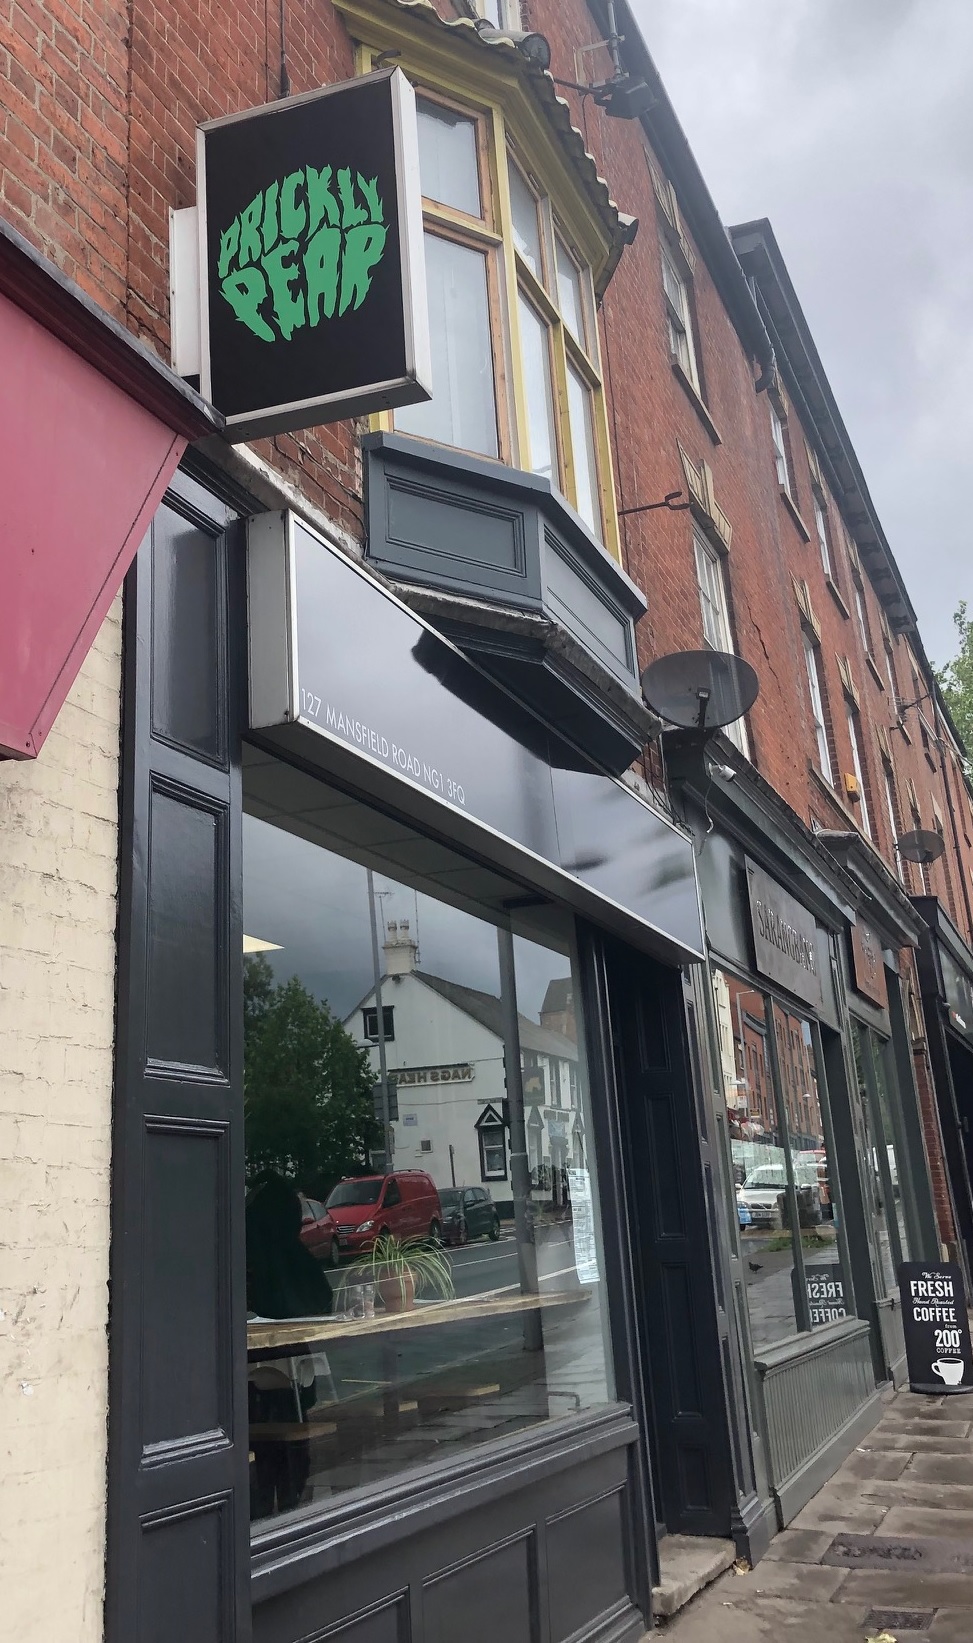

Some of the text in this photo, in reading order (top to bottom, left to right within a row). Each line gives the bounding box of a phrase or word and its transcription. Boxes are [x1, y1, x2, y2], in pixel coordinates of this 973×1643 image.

[217, 164, 384, 278] PRICKLY
[218, 223, 390, 342] PEAR
[301, 688, 466, 806] 127 MANSFIELD ROAD NG1 3FQ
[910, 1280, 954, 1297] FRESH
[912, 1297, 930, 1305] Hand
[913, 1307, 957, 1322] COFFEE
